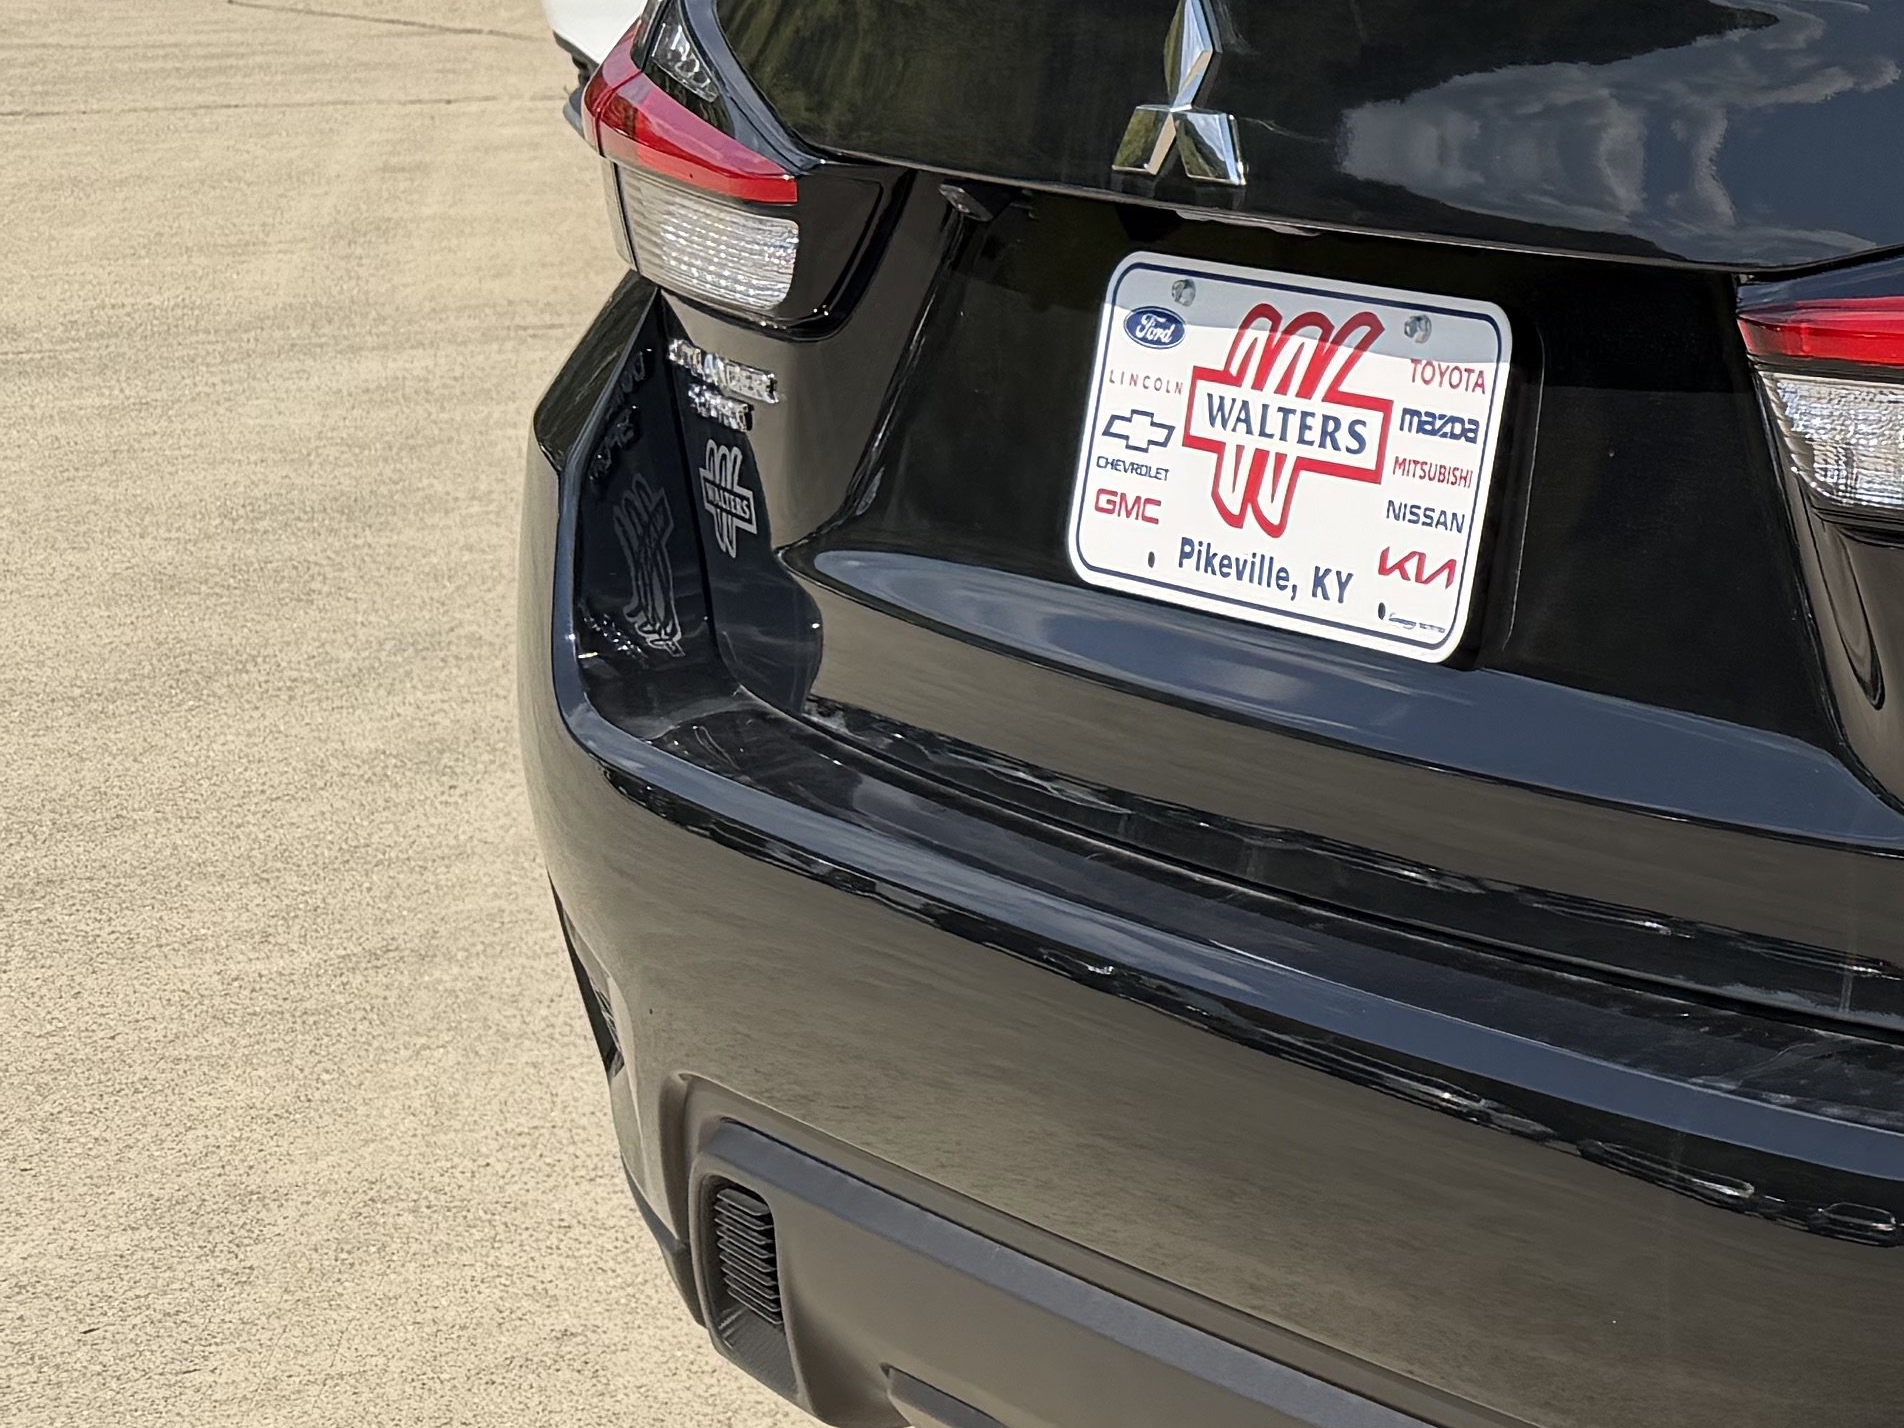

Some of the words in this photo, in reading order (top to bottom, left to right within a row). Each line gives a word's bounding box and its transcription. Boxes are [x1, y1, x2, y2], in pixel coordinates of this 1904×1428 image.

[1135, 313, 1176, 344] Ford
[1109, 370, 1183, 395] LINCOLN
[1411, 358, 1485, 394] TOYOTA
[1207, 393, 1367, 455] WALTERS
[1096, 455, 1170, 481] CHEVROLET
[1392, 456, 1474, 489] MITSUBISHI
[705, 482, 750, 520] WALTERS
[1095, 488, 1162, 525] GMC
[1386, 500, 1465, 533] NISSAN
[1178, 536, 1298, 601] Pikeville,
[1311, 566, 1355, 603] KY
